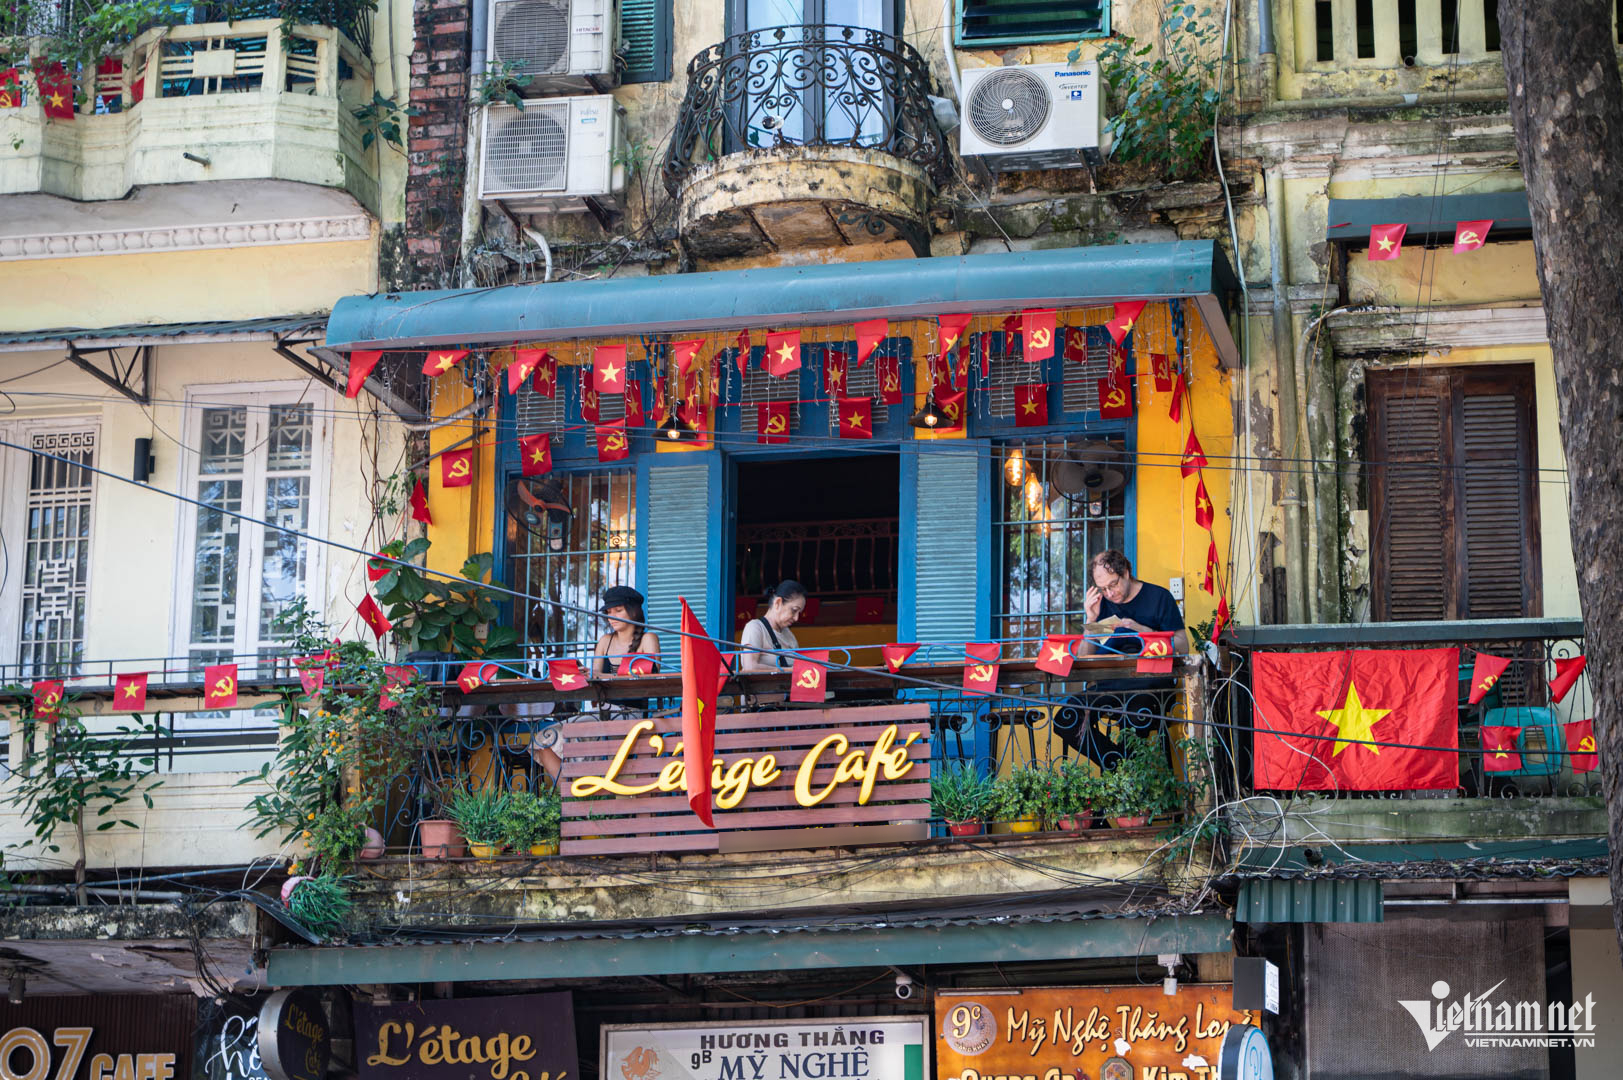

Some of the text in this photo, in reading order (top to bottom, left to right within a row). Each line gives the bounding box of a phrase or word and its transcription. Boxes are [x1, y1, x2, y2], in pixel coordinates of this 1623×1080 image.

[571, 720, 921, 809] L'éage Café
[366, 1022, 537, 1080] L'étage
[700, 1032, 789, 1050] HƯƠNG
[1007, 1003, 1252, 1056] Mỹ Nghệ Thăng Lon
[719, 1050, 768, 1080] MỸ
